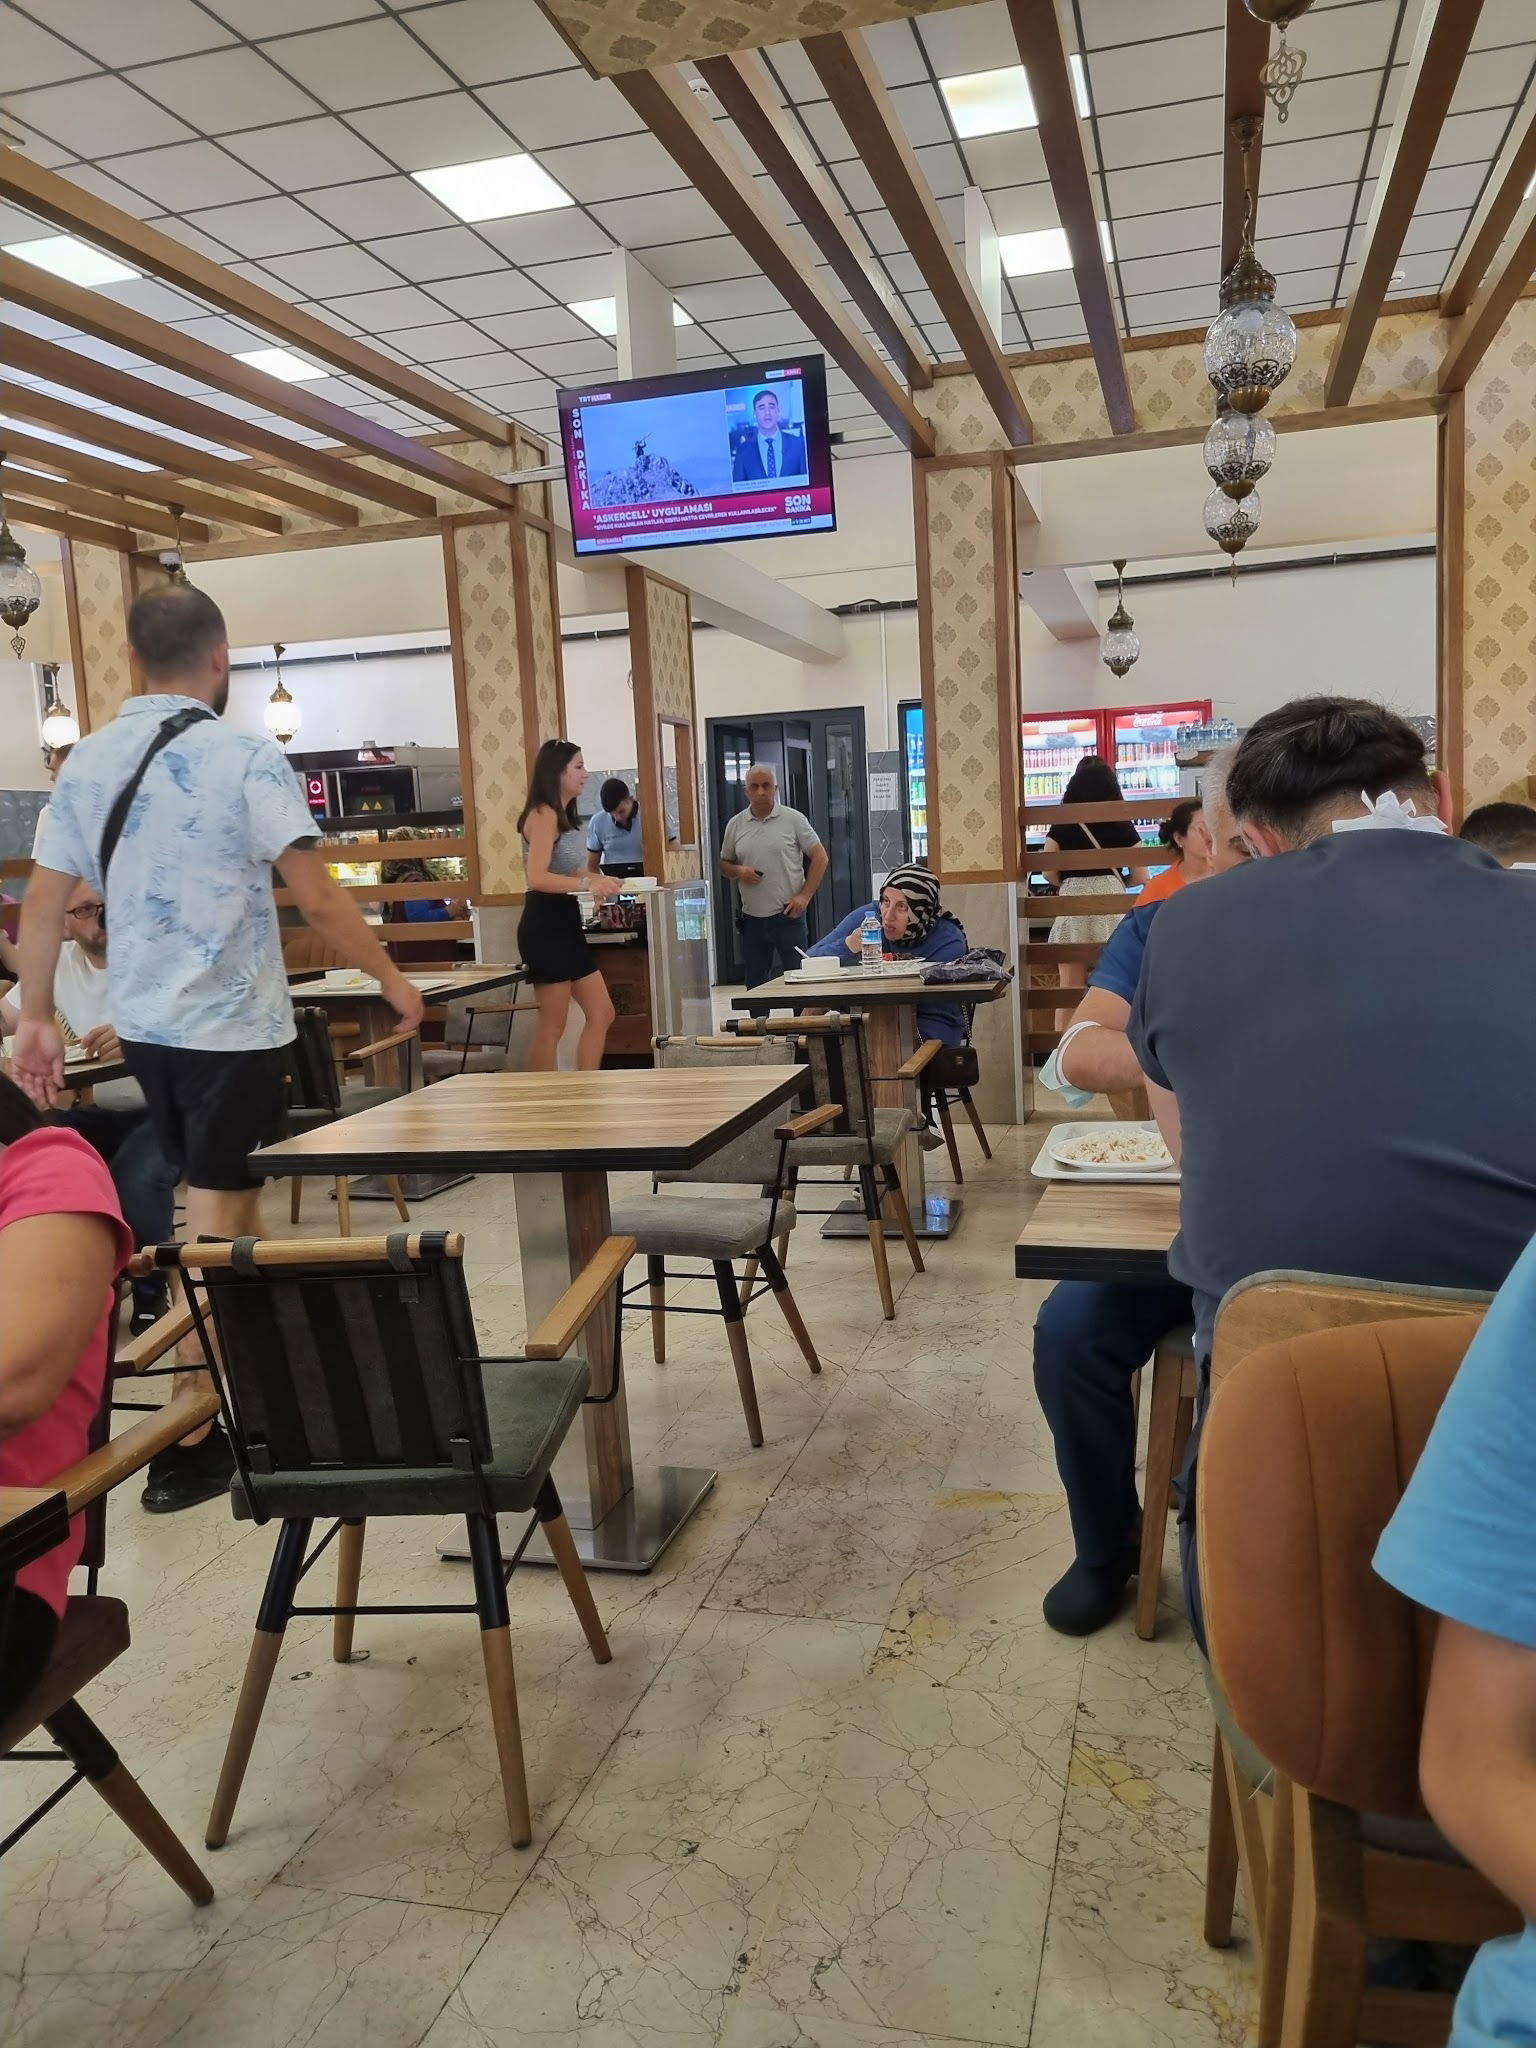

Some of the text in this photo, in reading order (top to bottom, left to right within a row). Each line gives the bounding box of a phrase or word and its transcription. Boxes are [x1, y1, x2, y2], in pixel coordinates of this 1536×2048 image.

[572, 408, 582, 439] SON
[784, 494, 811, 506] SON
[652, 502, 713, 518] UYGULAMASI
